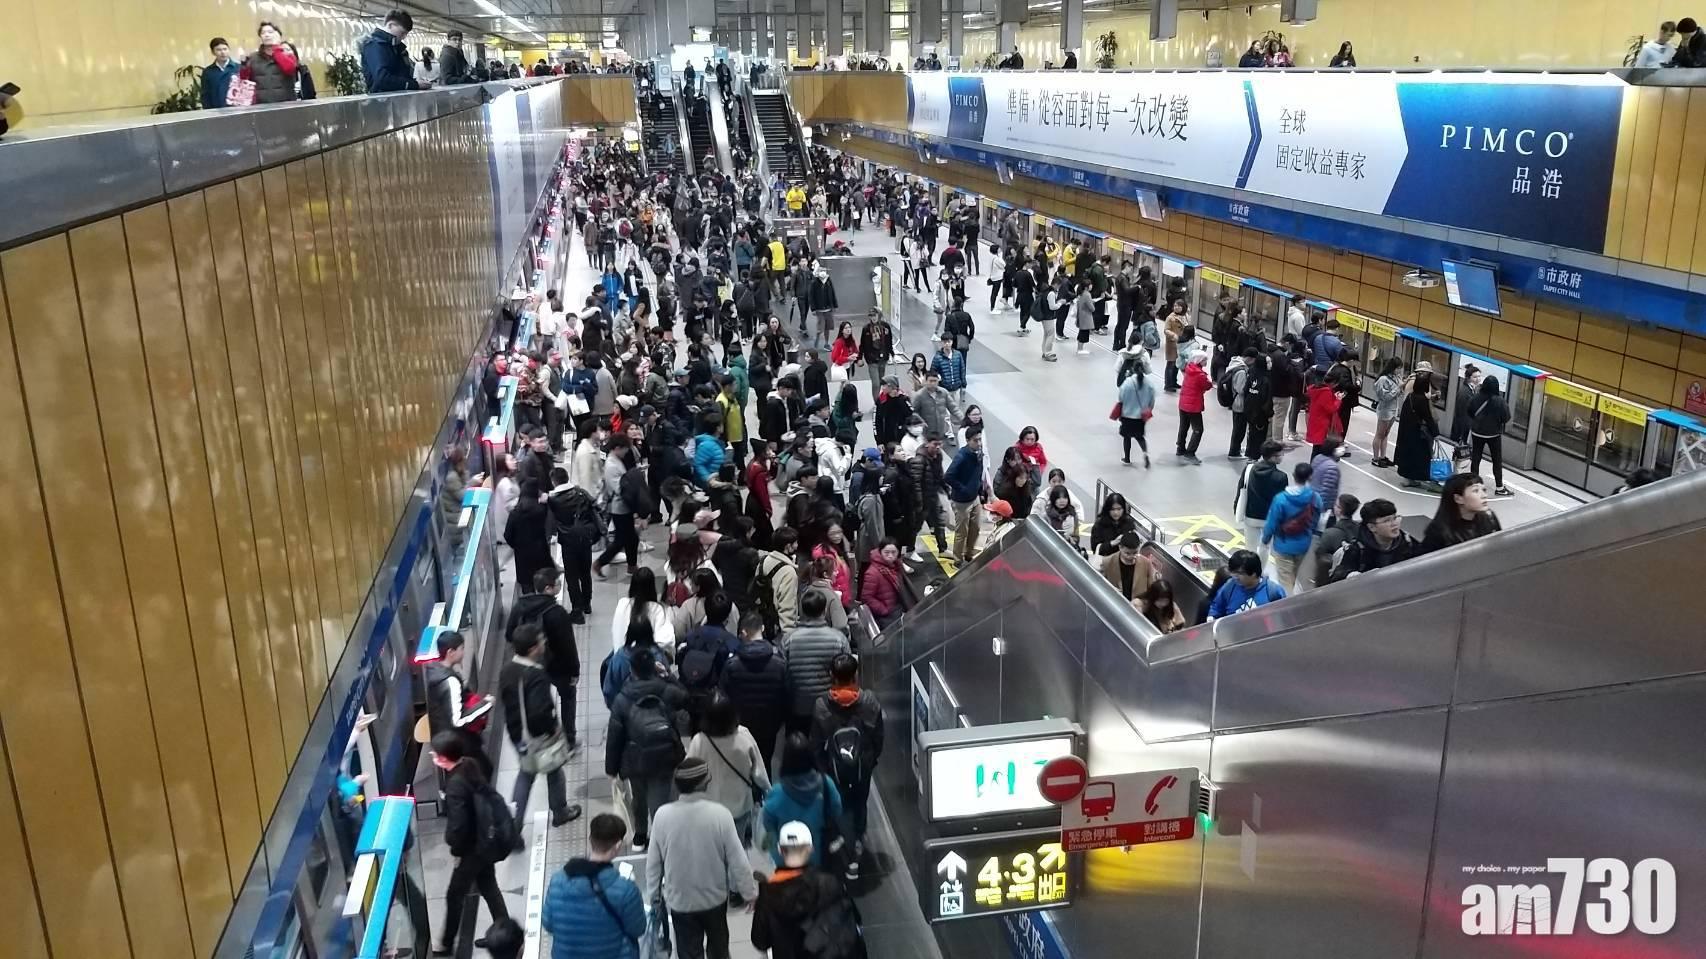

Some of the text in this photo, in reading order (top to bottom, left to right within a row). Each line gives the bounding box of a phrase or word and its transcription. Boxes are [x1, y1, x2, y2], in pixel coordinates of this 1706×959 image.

[955, 94, 978, 107] PIMCO
[1279, 108, 1306, 135] 全球
[1276, 144, 1366, 180] 固定收益專家
[1511, 166, 1563, 199] 品浩
[1547, 267, 1582, 289] 市政府
[1143, 834, 1176, 843] Intercom
